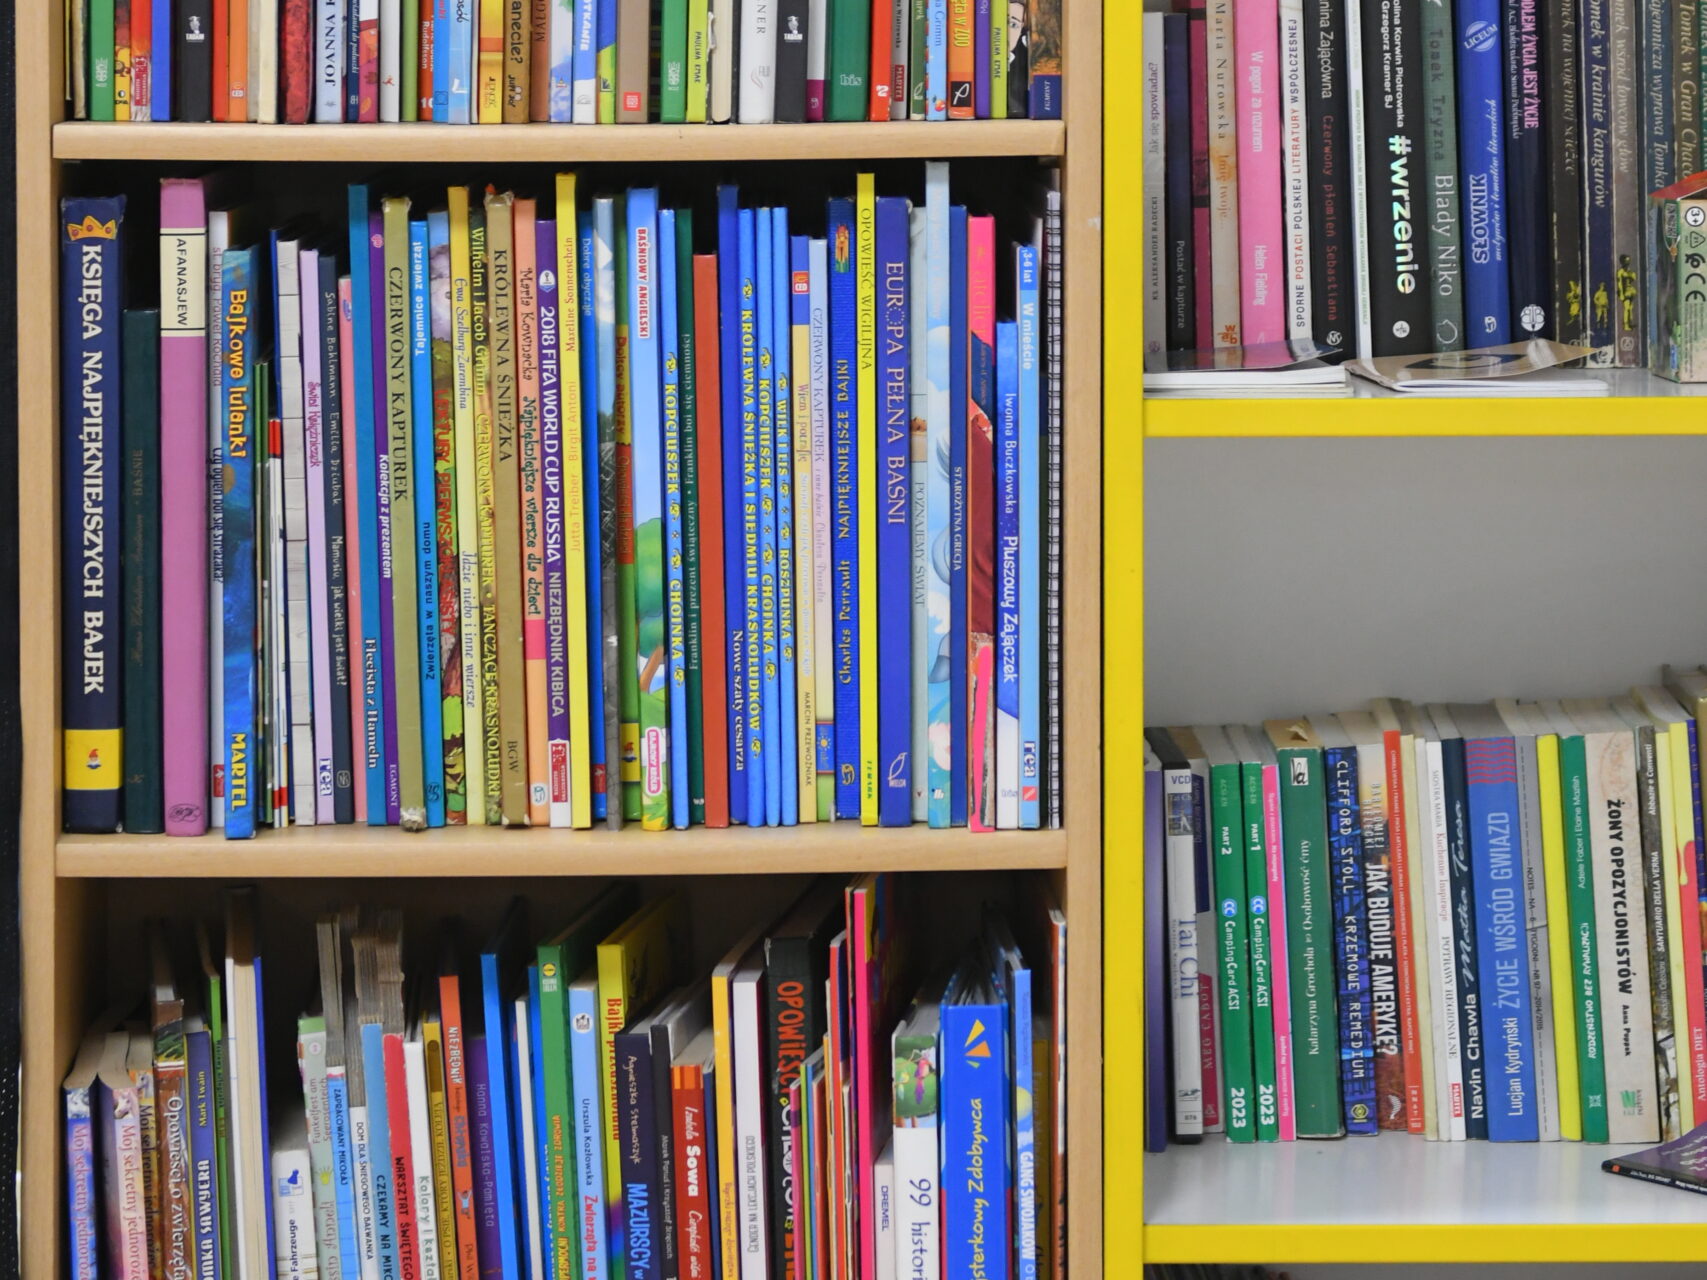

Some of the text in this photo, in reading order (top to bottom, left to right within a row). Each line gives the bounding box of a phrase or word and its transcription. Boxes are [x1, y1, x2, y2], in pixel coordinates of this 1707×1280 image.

[324, 13, 337, 86] JOANNA
[1317, 31, 1335, 98] Zającówna
[1592, 45, 1603, 58] w
[1592, 64, 1607, 121] krainie
[1589, 127, 1608, 207] kangurów
[1388, 135, 1419, 294] #wrzenie
[1433, 175, 1456, 296] Blady Niko
[1470, 174, 1489, 263] SŁOWNIK
[176, 238, 188, 326] AFANASJEW
[493, 249, 516, 462] KRÓLEWNA ŚNIEŻKA
[858, 295, 873, 370] WIGILIJNA
[227, 290, 249, 458] Bajkowe lulanki
[388, 266, 409, 502] CZERWONY KAPTUREK
[886, 367, 905, 443] PEŁNA
[80, 244, 103, 695] KSIĘGA NAJPIĘKNIEJSZYCH BAJEK
[886, 455, 909, 525] BAŚNI
[541, 306, 565, 716] 2018 FIFA WORLD CUP RUSSIA NIEZBĘDNIK KIBICA
[665, 384, 684, 660] KOPCIUSZEK CHOINKA
[999, 393, 1021, 683] Iwonna Buczkowska Pluszowy Zajączek
[231, 734, 246, 810] MARTEL
[1221, 827, 1229, 845] PART
[1250, 824, 1258, 842] PART
[1336, 761, 1364, 1078] CLIFFORD STOLL KRZEMOWE REMEDIUM
[1607, 799, 1636, 995] ŻONY OPOZYCJONISTÓW
[1224, 921, 1238, 986] CampingCard
[1253, 918, 1266, 982] CampingCard
[1366, 862, 1398, 1055] JAK BUDUJĘ AMERYKĘ?
[1487, 812, 1523, 1116] Lucjan Kydryński ŻYCIE WŚRÓD GWIAZD
[1228, 988, 1239, 1010] ACSI
[1256, 984, 1268, 1007] ACSI
[1464, 994, 1484, 1118] Navin Chawla
[582, 1098, 594, 1185] Urszula Kozłowska
[1231, 1088, 1246, 1128] 2023
[1259, 1085, 1273, 1125] 2023
[687, 1145, 702, 1196] Sowa
[966, 1098, 988, 1193] Zdobywca
[395, 1157, 410, 1215] WARSZTAT
[880, 1185, 890, 1232] DREMEL
[908, 1178, 932, 1207] 99
[626, 1183, 650, 1268] MAZURSCY
